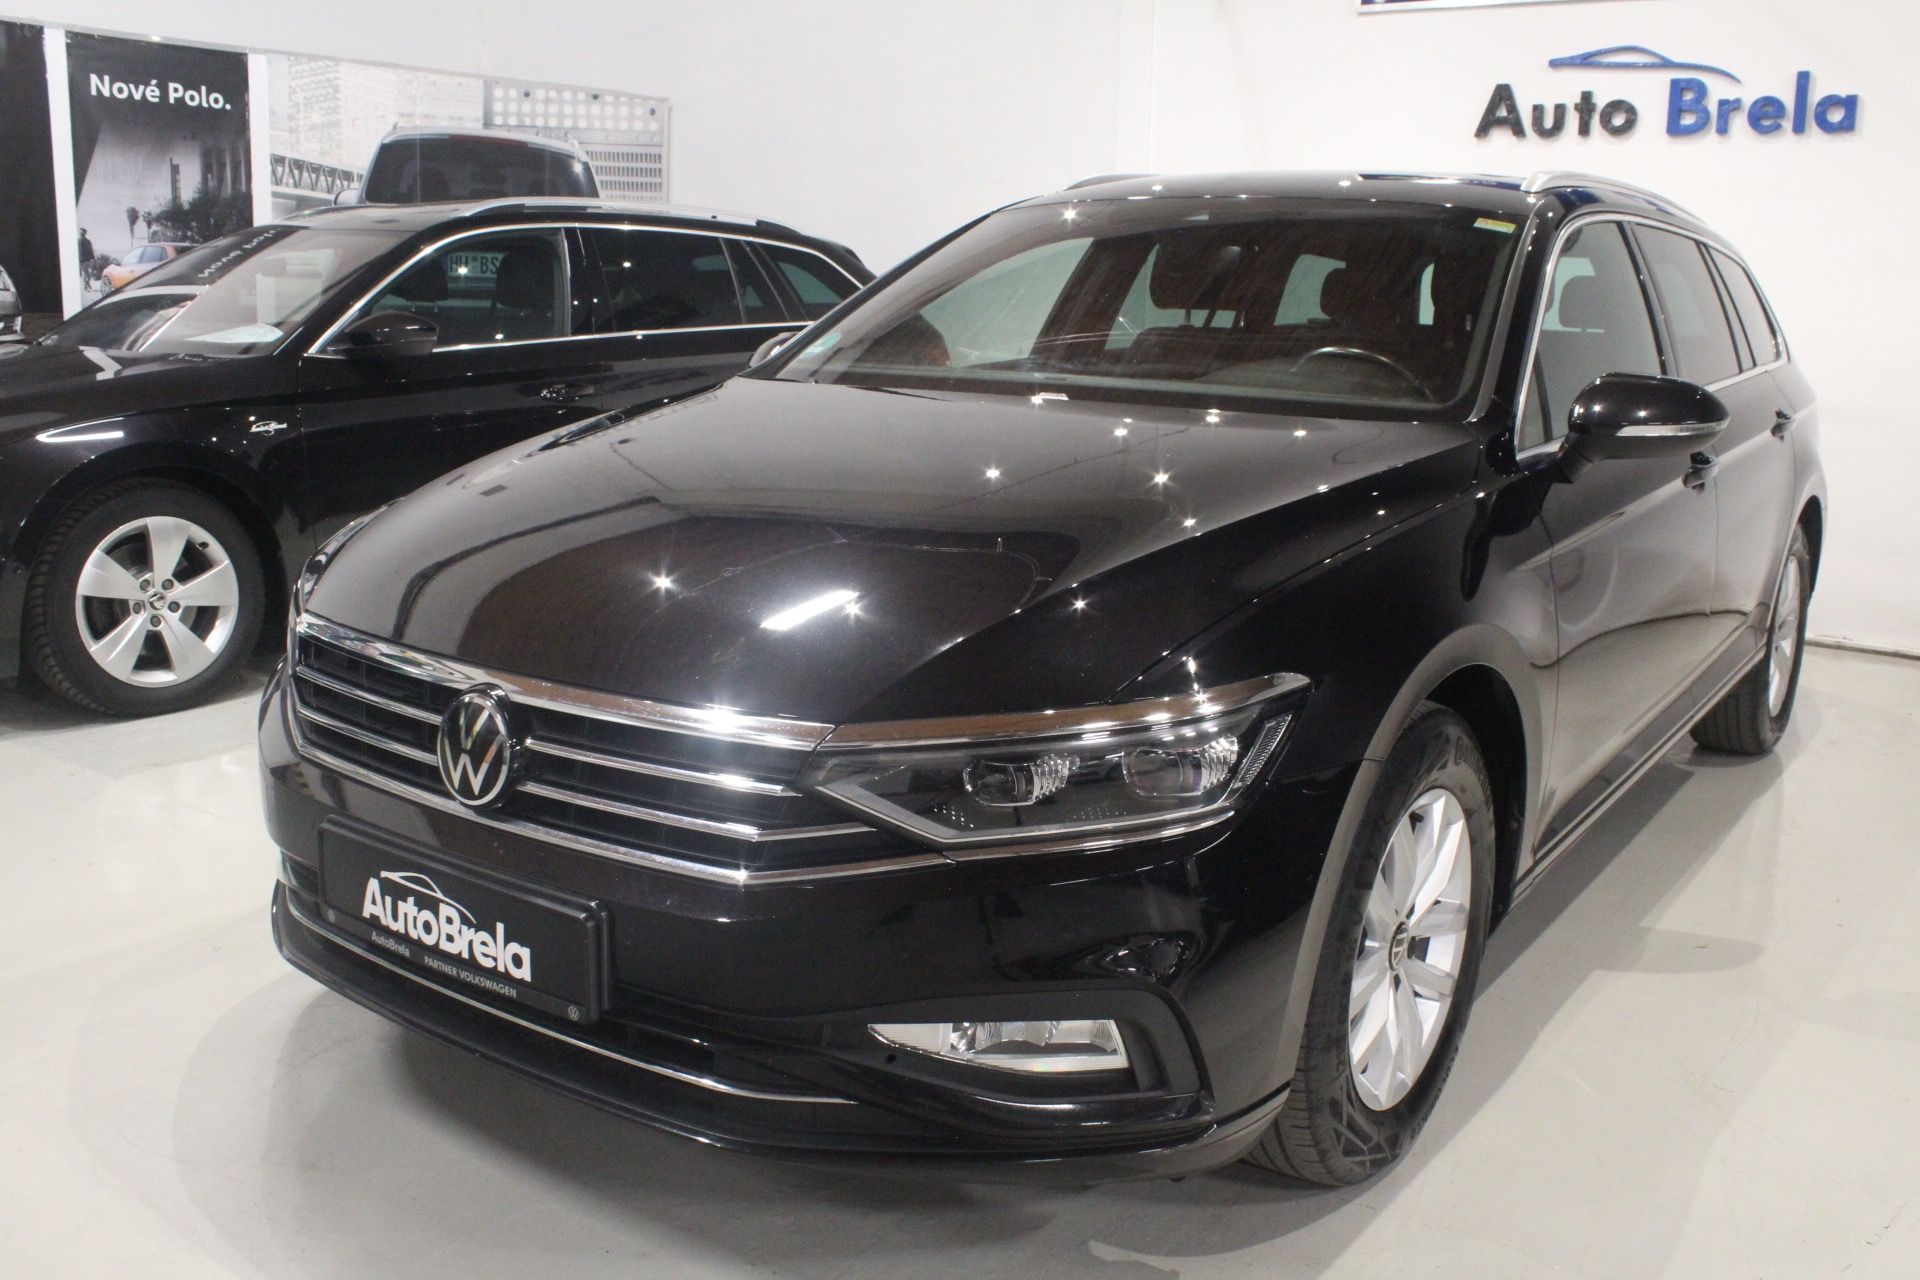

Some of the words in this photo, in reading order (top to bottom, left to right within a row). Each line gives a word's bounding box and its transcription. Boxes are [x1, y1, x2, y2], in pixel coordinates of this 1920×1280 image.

[90, 73, 161, 103] Nové
[168, 82, 232, 111] Polo.
[1474, 83, 1639, 138] Auto
[1666, 71, 1859, 136] Brela
[362, 877, 532, 983] AutoBrela
[371, 930, 410, 958] AutoBrela
[424, 956, 458, 977] PARTNER
[459, 969, 517, 998] VOLKSWAGEN
